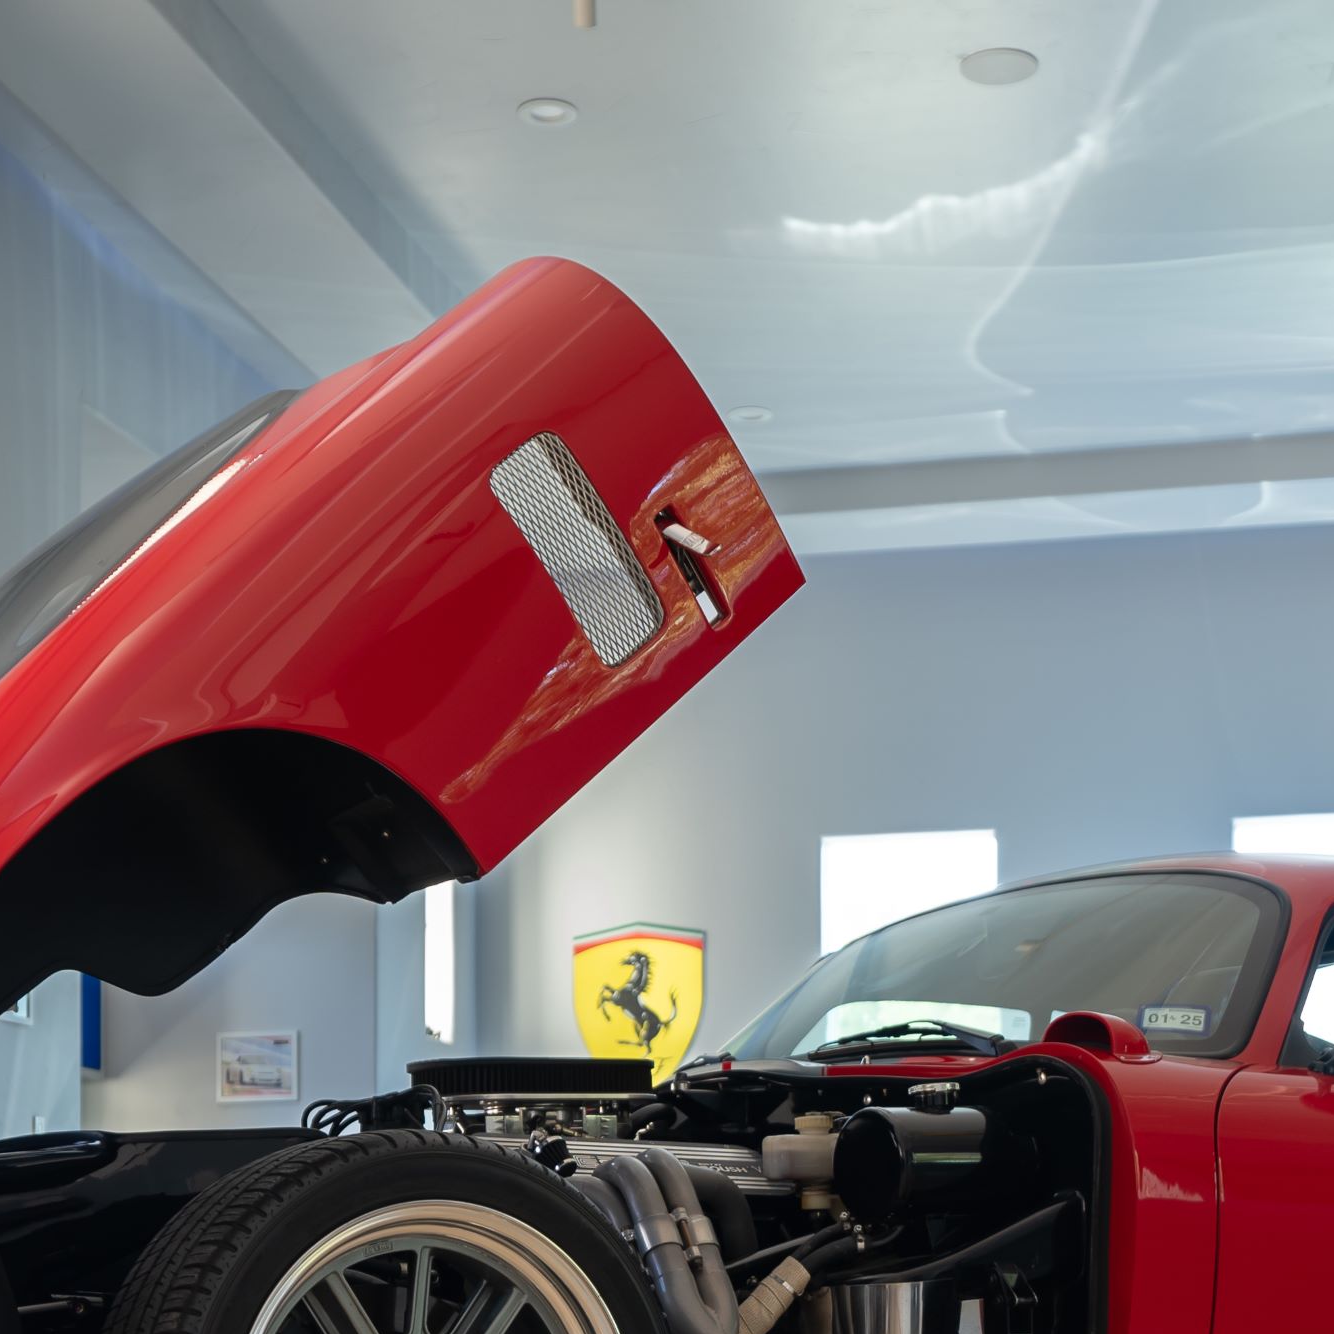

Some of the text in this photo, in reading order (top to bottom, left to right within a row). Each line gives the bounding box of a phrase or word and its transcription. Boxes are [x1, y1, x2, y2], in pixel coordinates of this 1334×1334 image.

[1148, 1013, 1203, 1026] 01 25
[700, 1165, 748, 1174] OUSH
